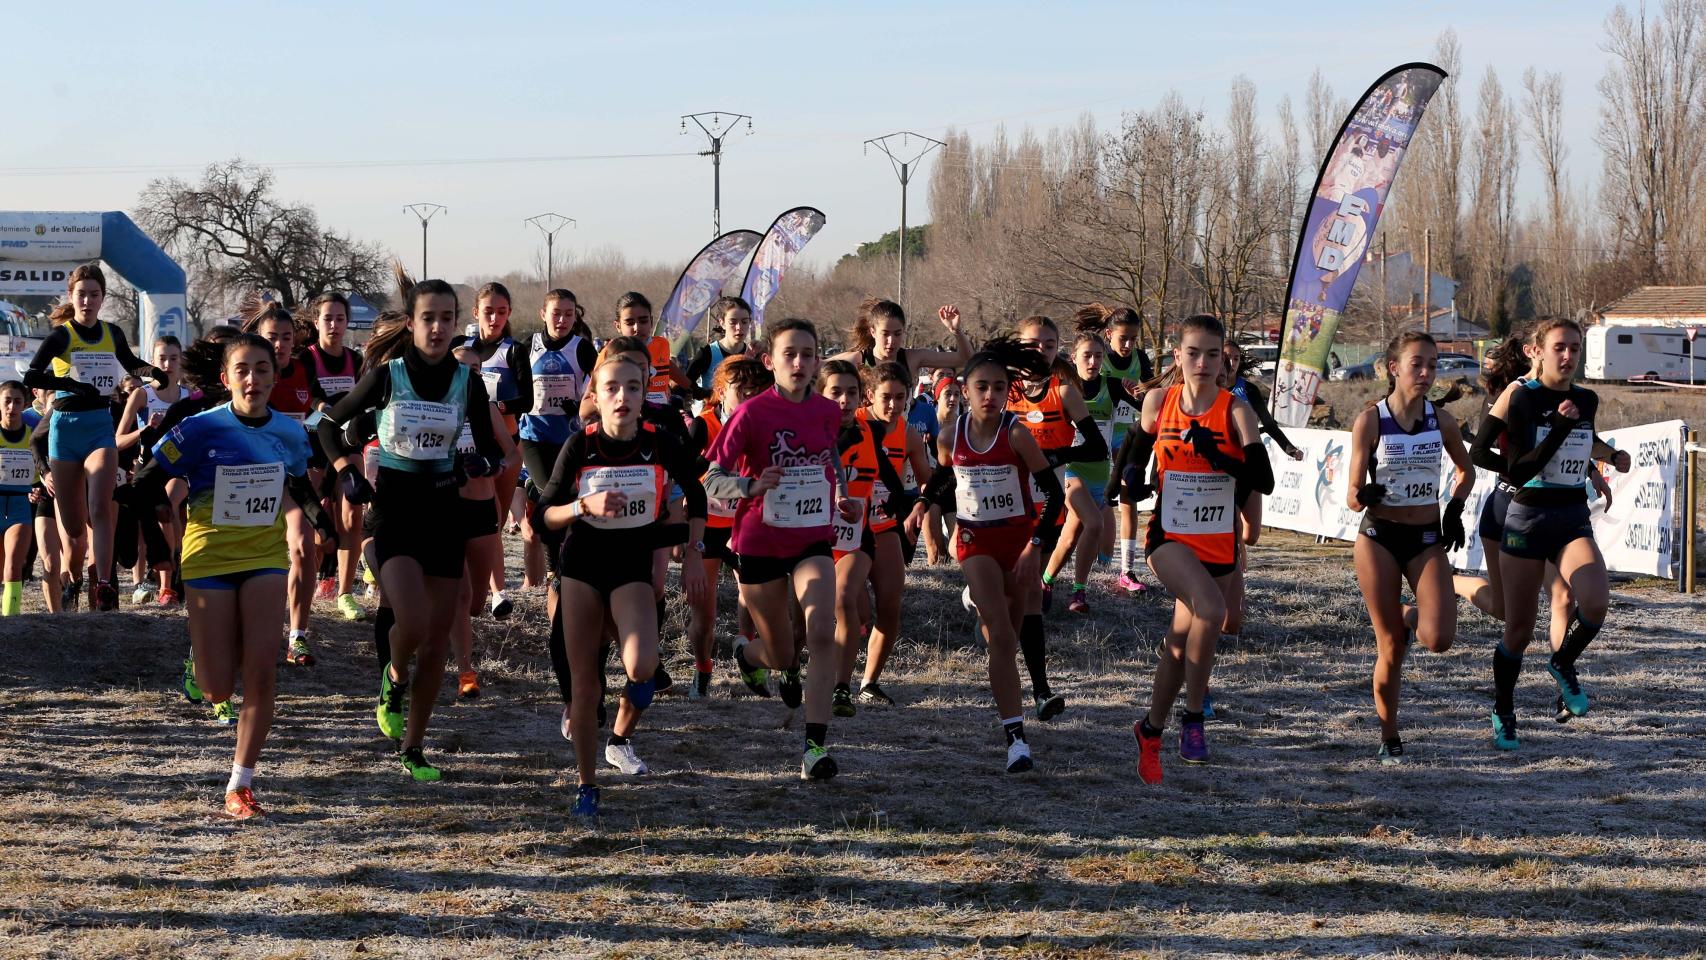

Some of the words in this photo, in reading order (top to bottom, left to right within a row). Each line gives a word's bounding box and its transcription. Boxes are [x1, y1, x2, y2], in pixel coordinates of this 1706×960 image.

[92, 376, 114, 388] 1275
[416, 432, 444, 448] 1252
[11, 469, 30, 478] 1273
[1560, 460, 1584, 474] 1227
[1405, 482, 1432, 498] 1245
[246, 497, 276, 513] 1247
[622, 500, 646, 516] 188
[728, 498, 738, 510] 12
[796, 498, 822, 515] 1222
[982, 493, 1013, 510] 1196
[1193, 506, 1224, 522] 1277
[834, 526, 854, 541] 279
